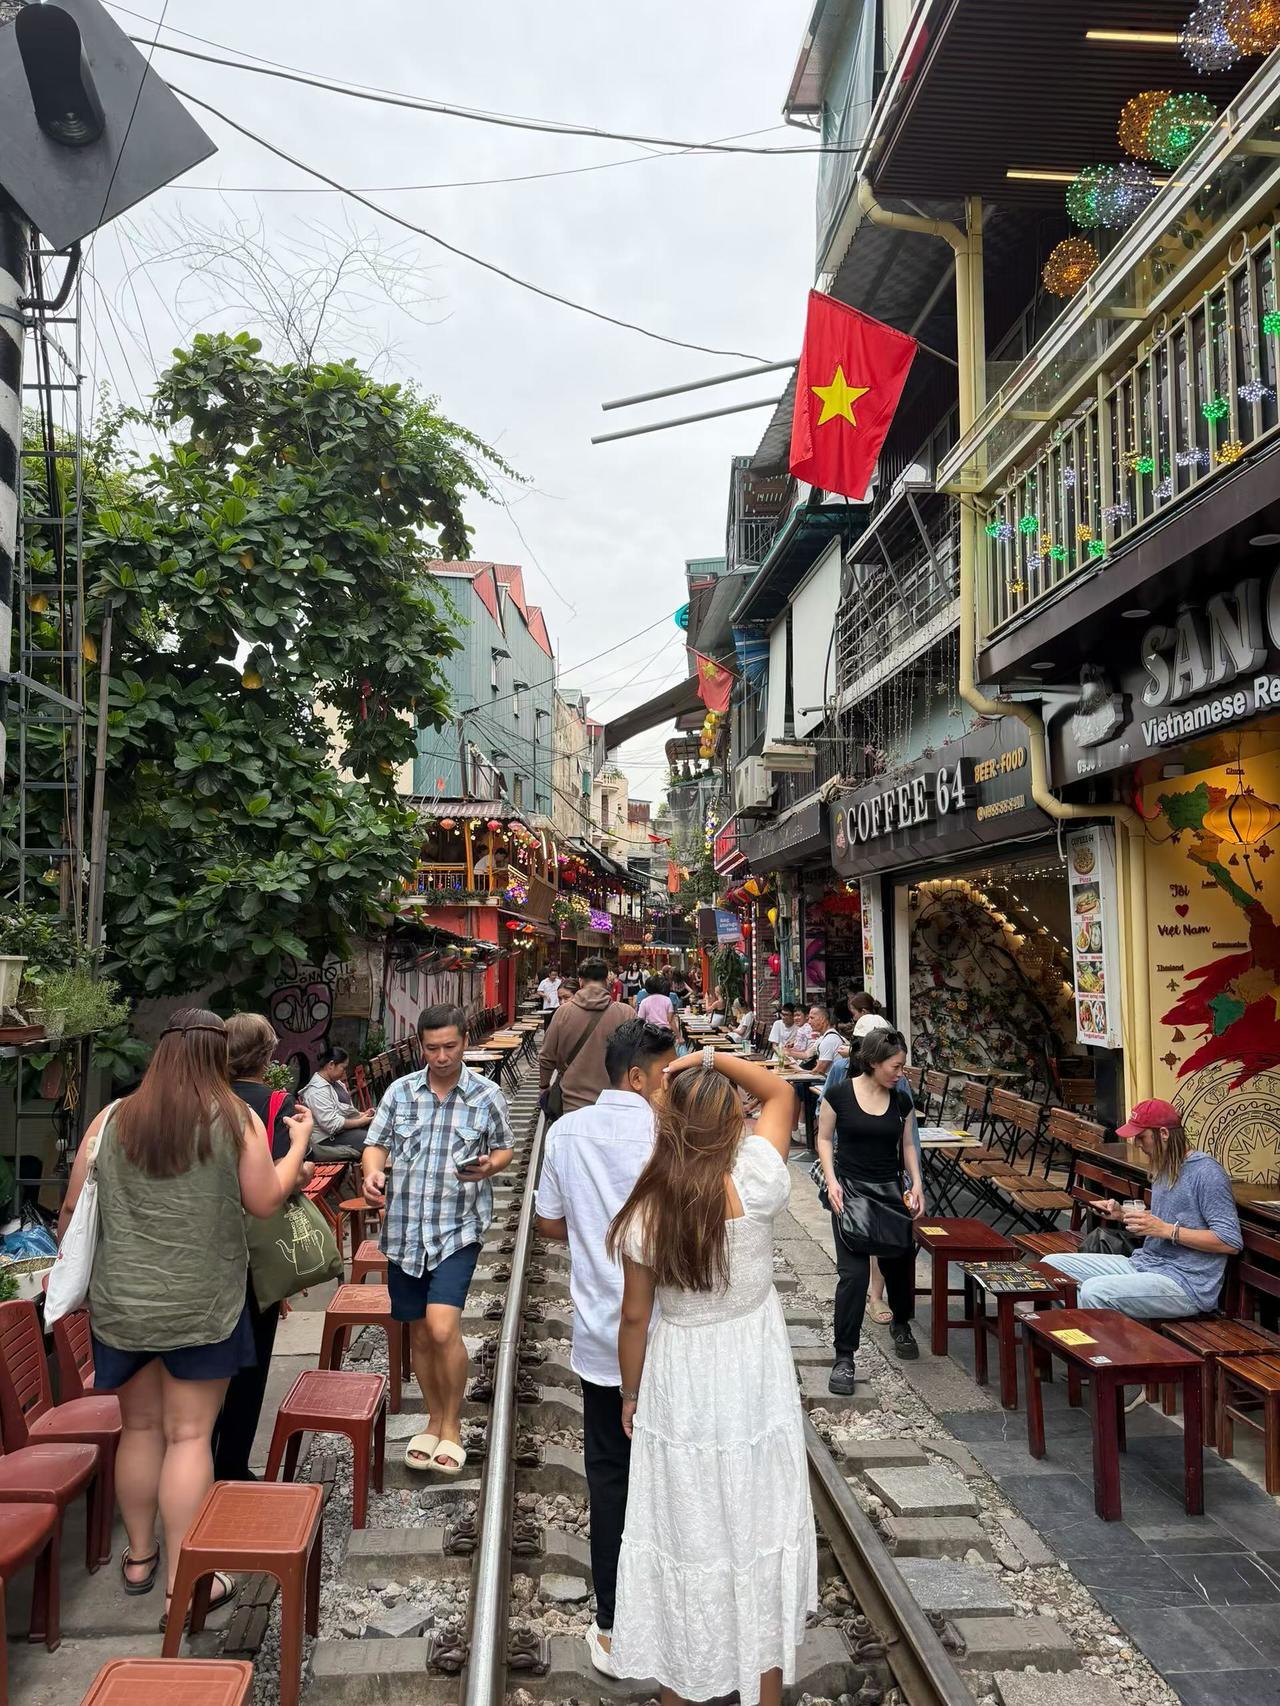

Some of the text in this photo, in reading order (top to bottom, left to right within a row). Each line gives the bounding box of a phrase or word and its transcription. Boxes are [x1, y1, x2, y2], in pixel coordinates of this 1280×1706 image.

[1141, 691, 1247, 748] Vietnamese
[847, 775, 929, 845] COFFEE
[936, 759, 966, 815] 64
[1183, 923, 1211, 936] Nam
